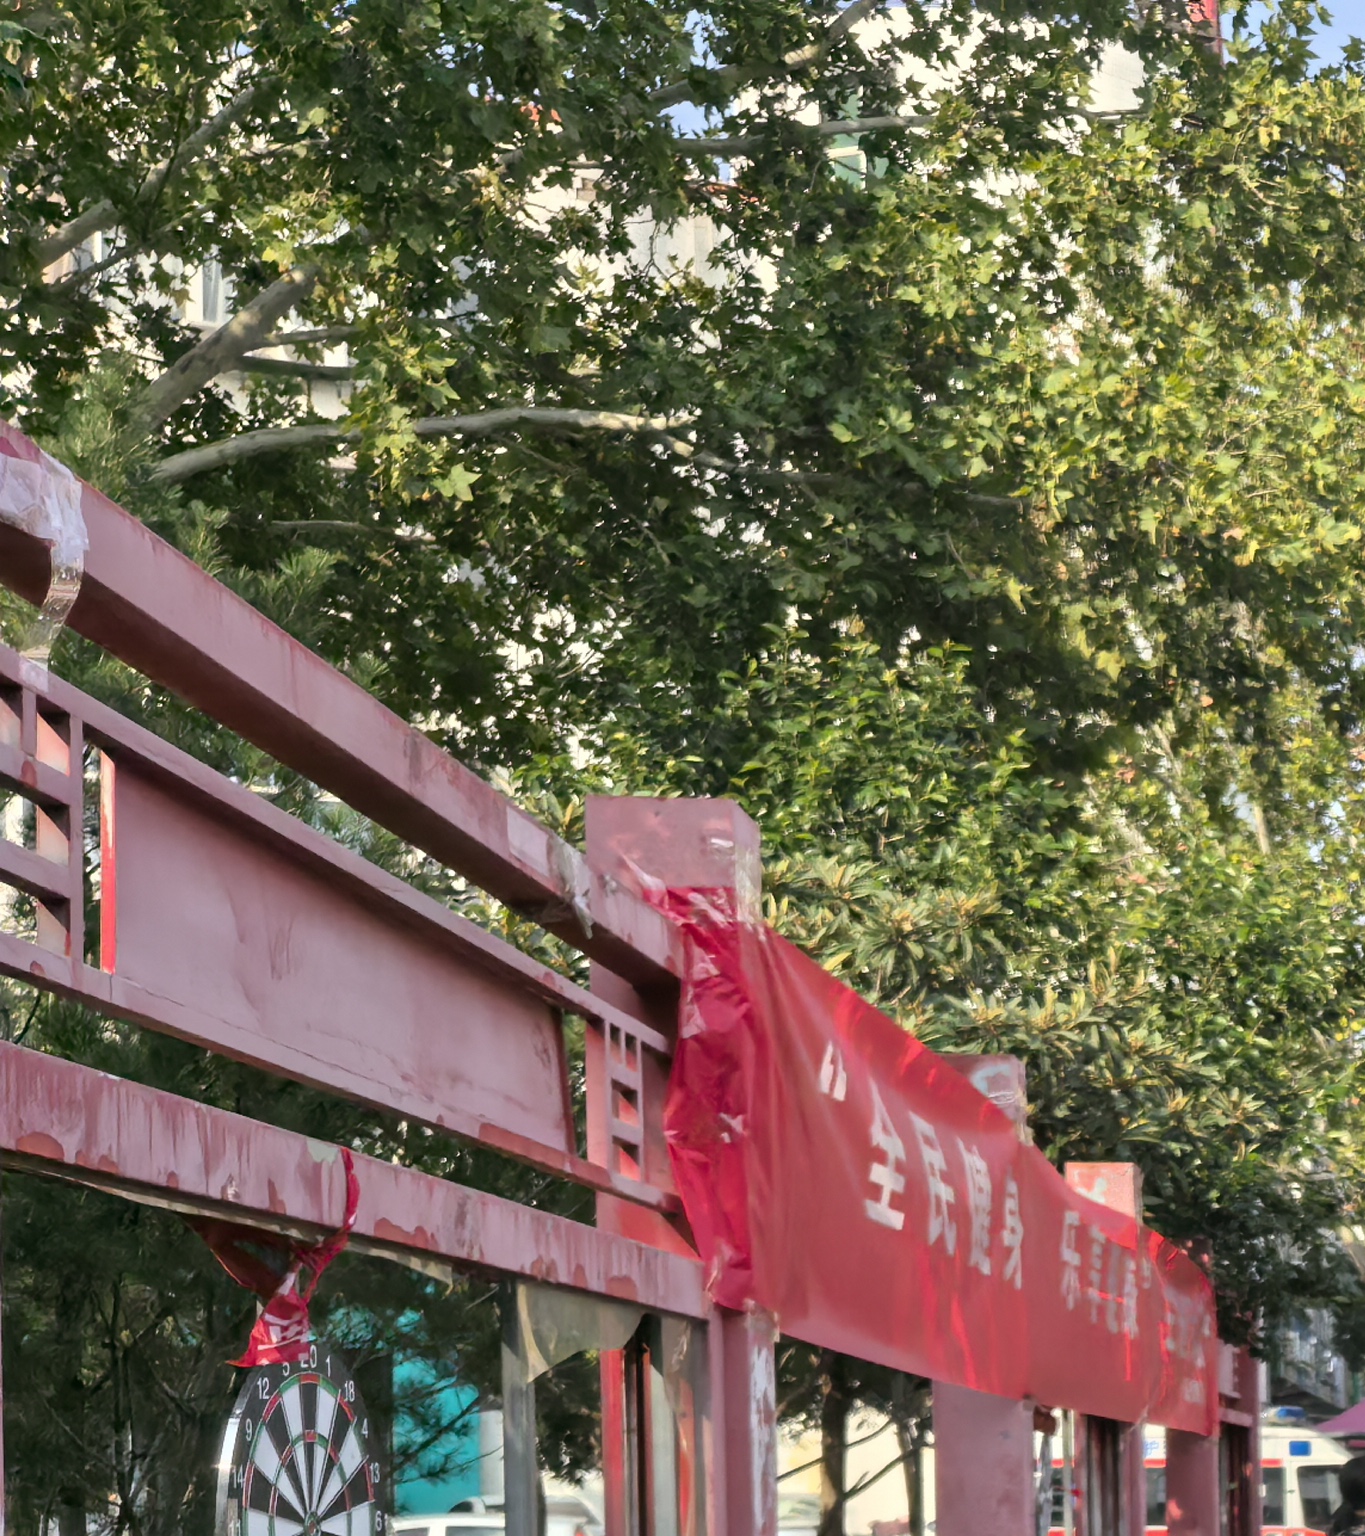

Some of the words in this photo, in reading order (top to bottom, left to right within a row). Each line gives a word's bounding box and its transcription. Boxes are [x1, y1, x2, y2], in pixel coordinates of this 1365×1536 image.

[325, 1355, 331, 1377] 1
[256, 1377, 270, 1400] 12
[344, 1380, 355, 1402] 18
[245, 1418, 253, 1441] 9
[361, 1418, 368, 1439] 4
[231, 1466, 243, 1489] 14
[369, 1462, 380, 1483] 13
[375, 1511, 382, 1531] 6
